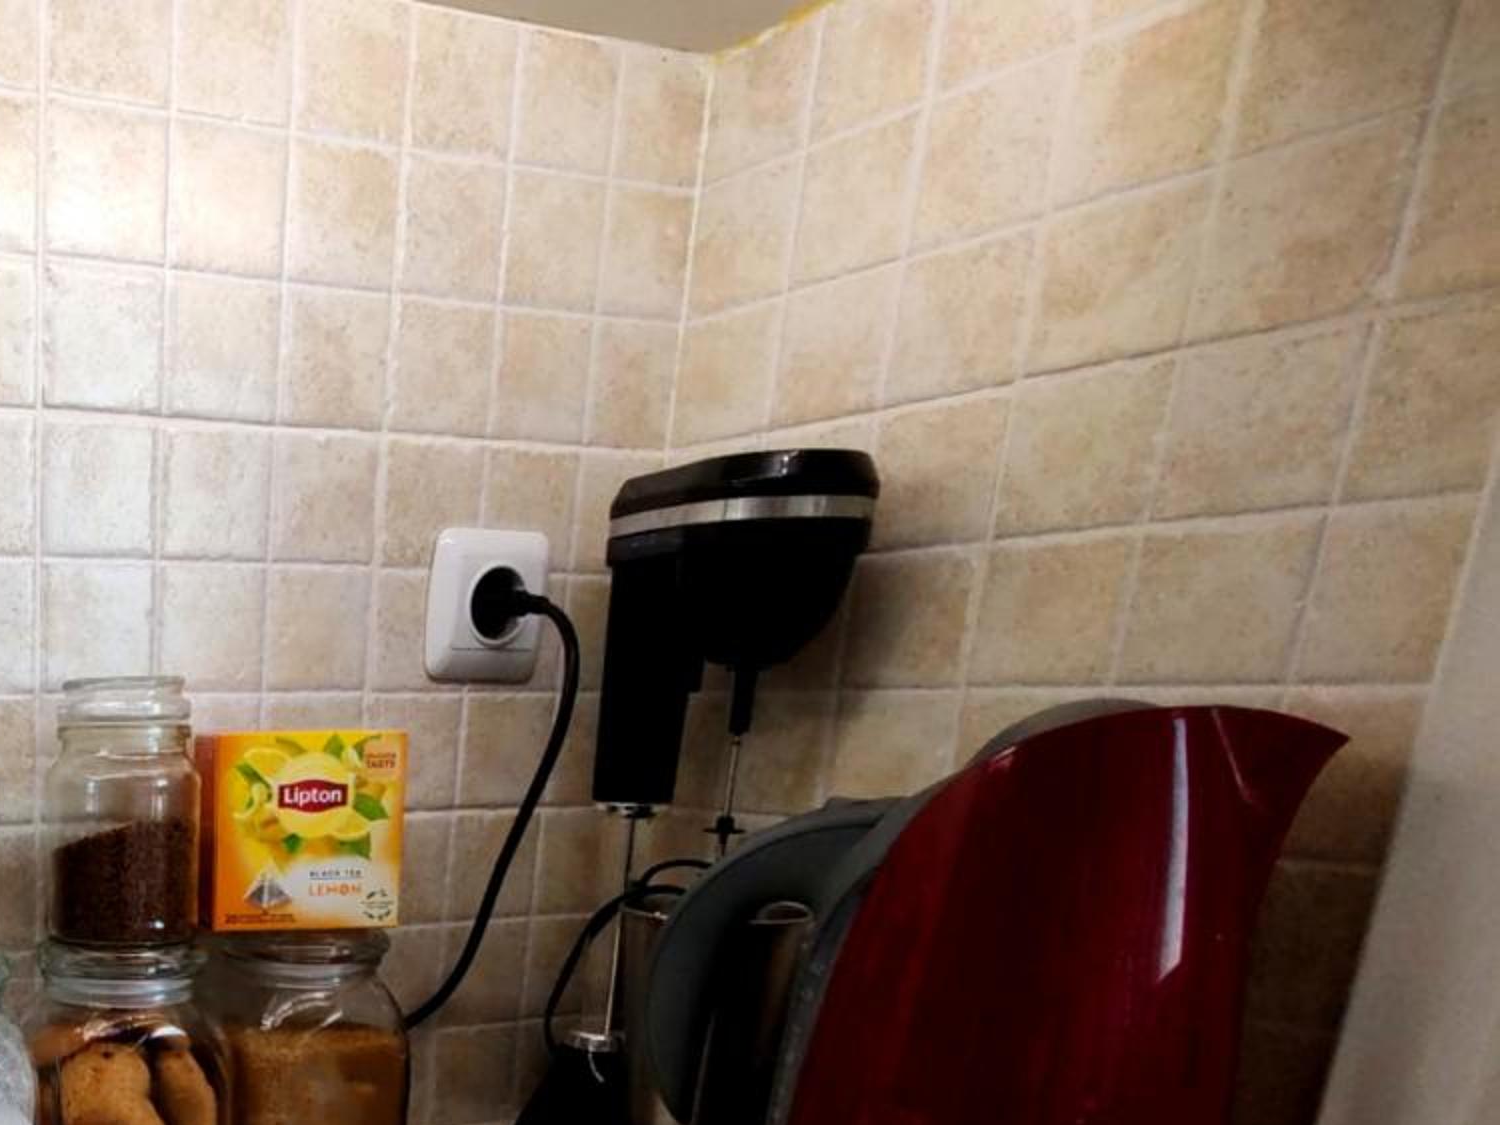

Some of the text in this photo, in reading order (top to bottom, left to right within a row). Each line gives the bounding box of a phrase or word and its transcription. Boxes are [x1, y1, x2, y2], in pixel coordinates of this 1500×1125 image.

[283, 787, 343, 807] Lipton
[309, 870, 341, 878] BLACK
[308, 883, 362, 897] LEMON
